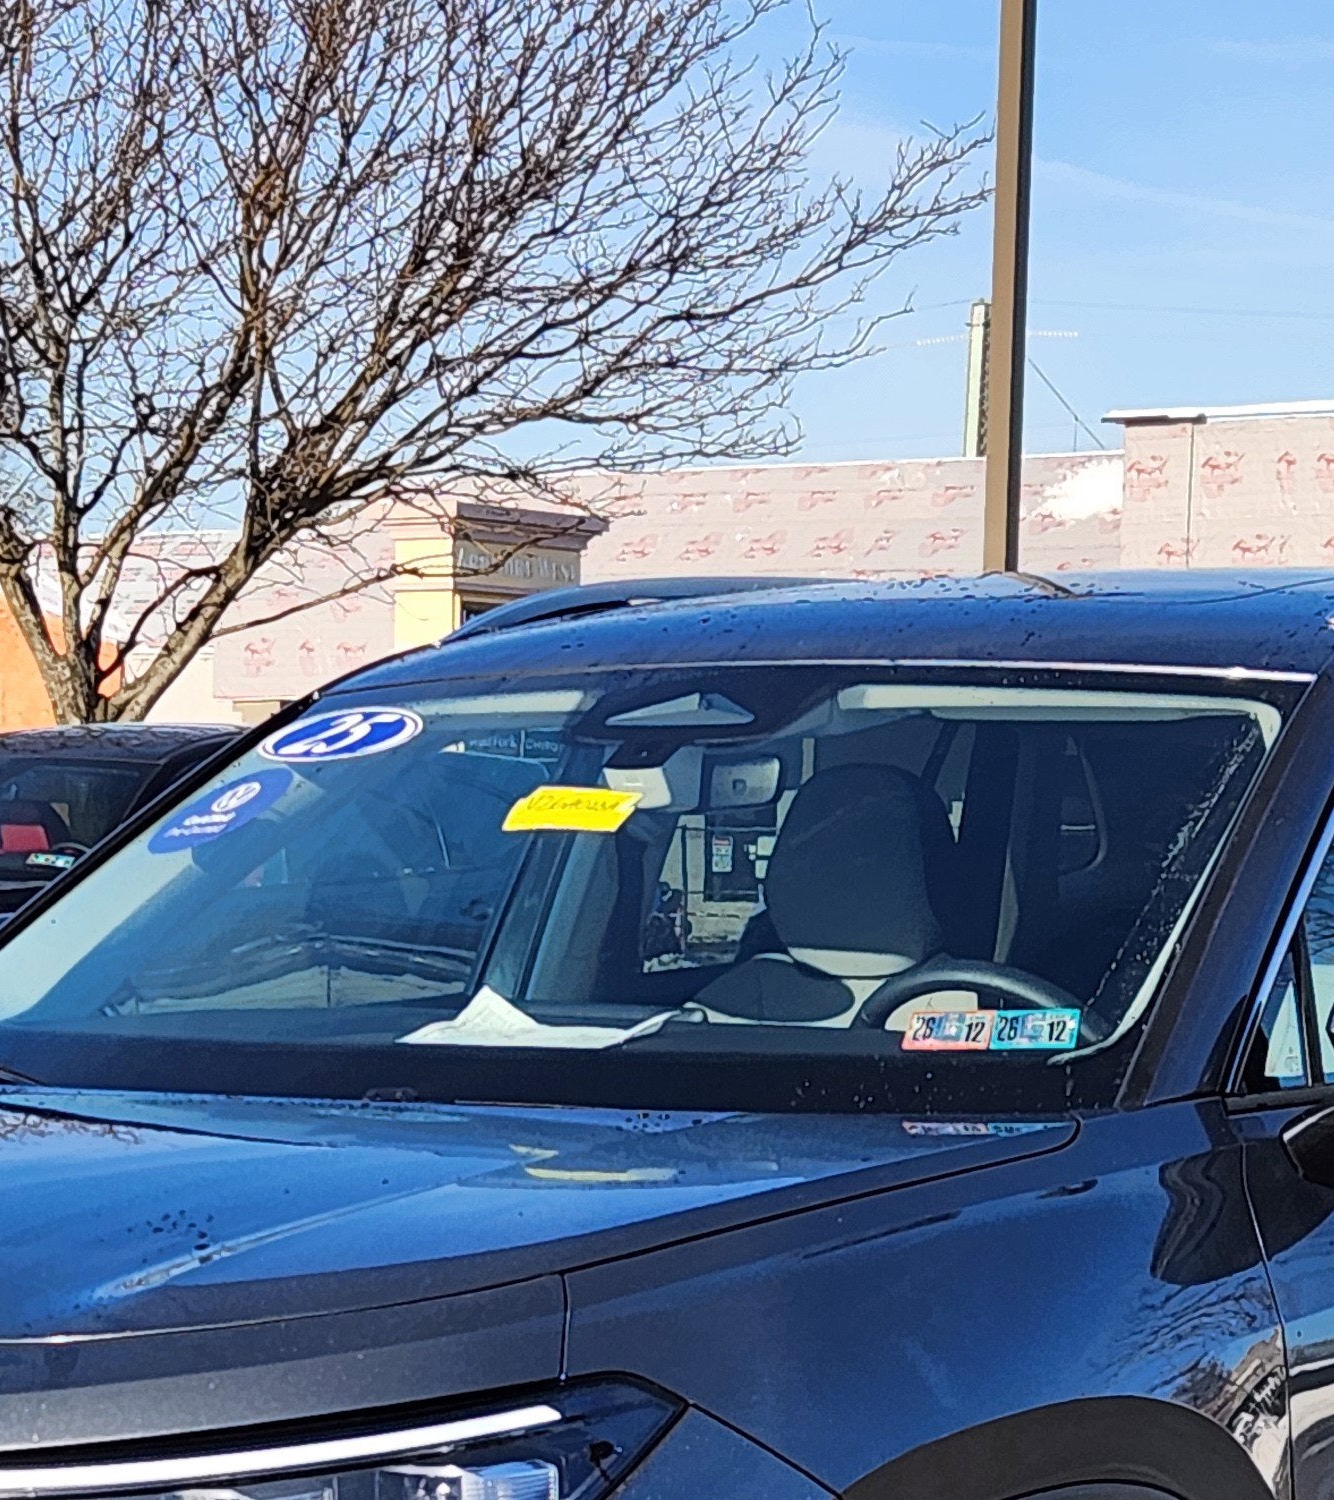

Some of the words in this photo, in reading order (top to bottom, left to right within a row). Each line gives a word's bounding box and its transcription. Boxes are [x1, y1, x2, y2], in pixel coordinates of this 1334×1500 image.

[277, 713, 403, 754] 25
[965, 1021, 986, 1043] 12
[1048, 1020, 1067, 1042] 12
